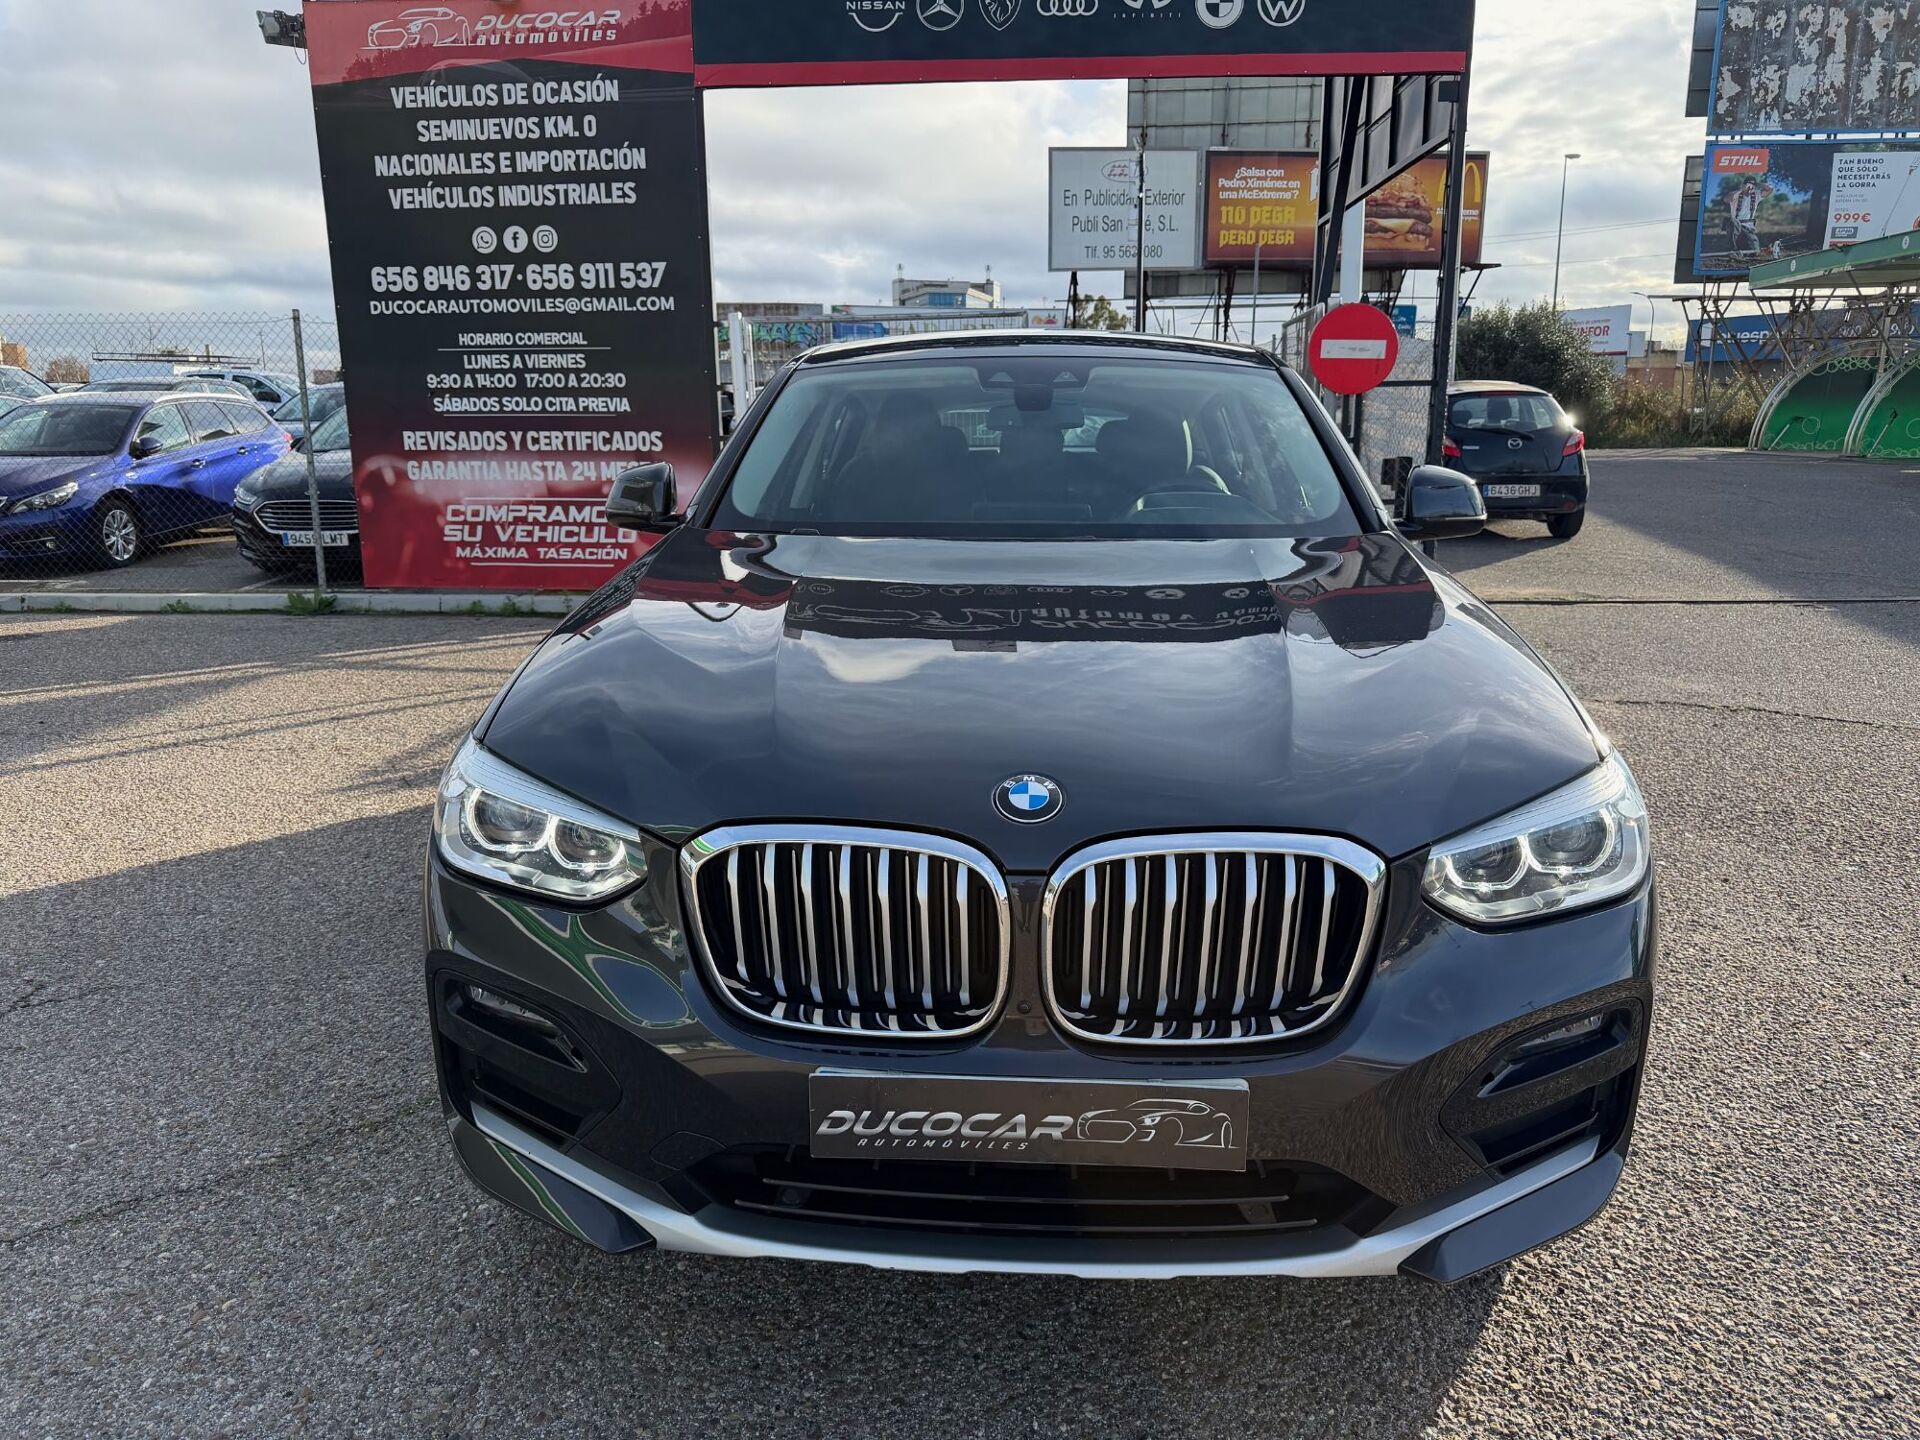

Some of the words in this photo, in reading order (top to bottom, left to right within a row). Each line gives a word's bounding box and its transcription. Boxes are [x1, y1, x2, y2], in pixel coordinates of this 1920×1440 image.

[846, 1, 905, 10] NISSAN
[475, 10, 621, 31] DUCOCAR
[391, 80, 498, 109] VEHÍCULOS
[502, 83, 529, 105] DE
[532, 73, 619, 104] OCASIÓN
[417, 117, 540, 142] SEMINUEVOS
[544, 115, 579, 138] KM.
[374, 152, 495, 176] NACIONALES
[499, 152, 512, 174] E
[515, 142, 646, 173] IMPORTACIÓN
[1719, 156, 1762, 166] STIHL
[1235, 167, 1265, 178] ¿Salsa
[1266, 169, 1284, 177] con
[1837, 173, 1891, 181] NECESITARÁS
[1218, 178, 1246, 188] Pedro
[1247, 178, 1287, 188] Ximénez
[1288, 180, 1300, 188] en
[388, 181, 495, 209] VEHÍCULOS
[498, 182, 637, 207] INDUSTRIALES
[1063, 189, 1078, 206] En
[1145, 188, 1185, 206] Exterior
[1219, 191, 1238, 199] una
[1072, 216, 1098, 232] Publi
[1102, 215, 1123, 232] San
[1158, 215, 1179, 231] S.L.
[1220, 206, 1246, 225] NO
[1250, 206, 1296, 228] PEGA
[1834, 212, 1871, 223] 999€
[1219, 229, 1256, 248] PERO
[1259, 229, 1295, 247] PEGA
[1085, 246, 1099, 259] Tlf.
[1103, 245, 1116, 258] 95
[371, 266, 418, 292] 656
[423, 265, 471, 291] 846
[476, 264, 514, 290] 317
[526, 263, 574, 290] 656
[579, 263, 614, 289] 911
[620, 262, 667, 289] 537
[370, 297, 675, 314] DUCOCARAUTOMOVILES@GMAIL.COM
[459, 333, 513, 346] HORARIO
[515, 332, 588, 345] COMERCIAL
[464, 354, 510, 369] LUNES
[512, 354, 523, 369] A
[524, 353, 586, 369] VIERNES
[427, 374, 461, 388] 9:30
[464, 374, 474, 388] A
[475, 373, 517, 388] 14:00
[525, 373, 565, 388] 17:00
[568, 373, 578, 388] A
[580, 373, 626, 388] 20:30
[434, 394, 500, 412] SÁBADOS
[502, 397, 542, 412] SOLO
[545, 397, 576, 411] CITA
[579, 397, 631, 412] PREVIA
[403, 431, 508, 451] REVISADOS
[509, 431, 523, 451] Y
[526, 431, 663, 452] CERTIFICADOS
[506, 461, 567, 481] HASTA
[572, 461, 597, 481] 24
[1490, 486, 1516, 495] 6436
[1518, 486, 1537, 495] GHJ
[446, 504, 608, 523] COMPRAMO
[321, 533, 345, 544] LMT
[443, 525, 482, 542] SU
[495, 525, 637, 544] VEHICULO
[456, 544, 529, 559] MÁXIMA
[537, 545, 627, 560] TASACIÓN
[1003, 775, 1056, 789] BMW
[816, 1110, 1074, 1140] DUCOCAR
[857, 1138, 1028, 1150] AUTOMÓVILES
